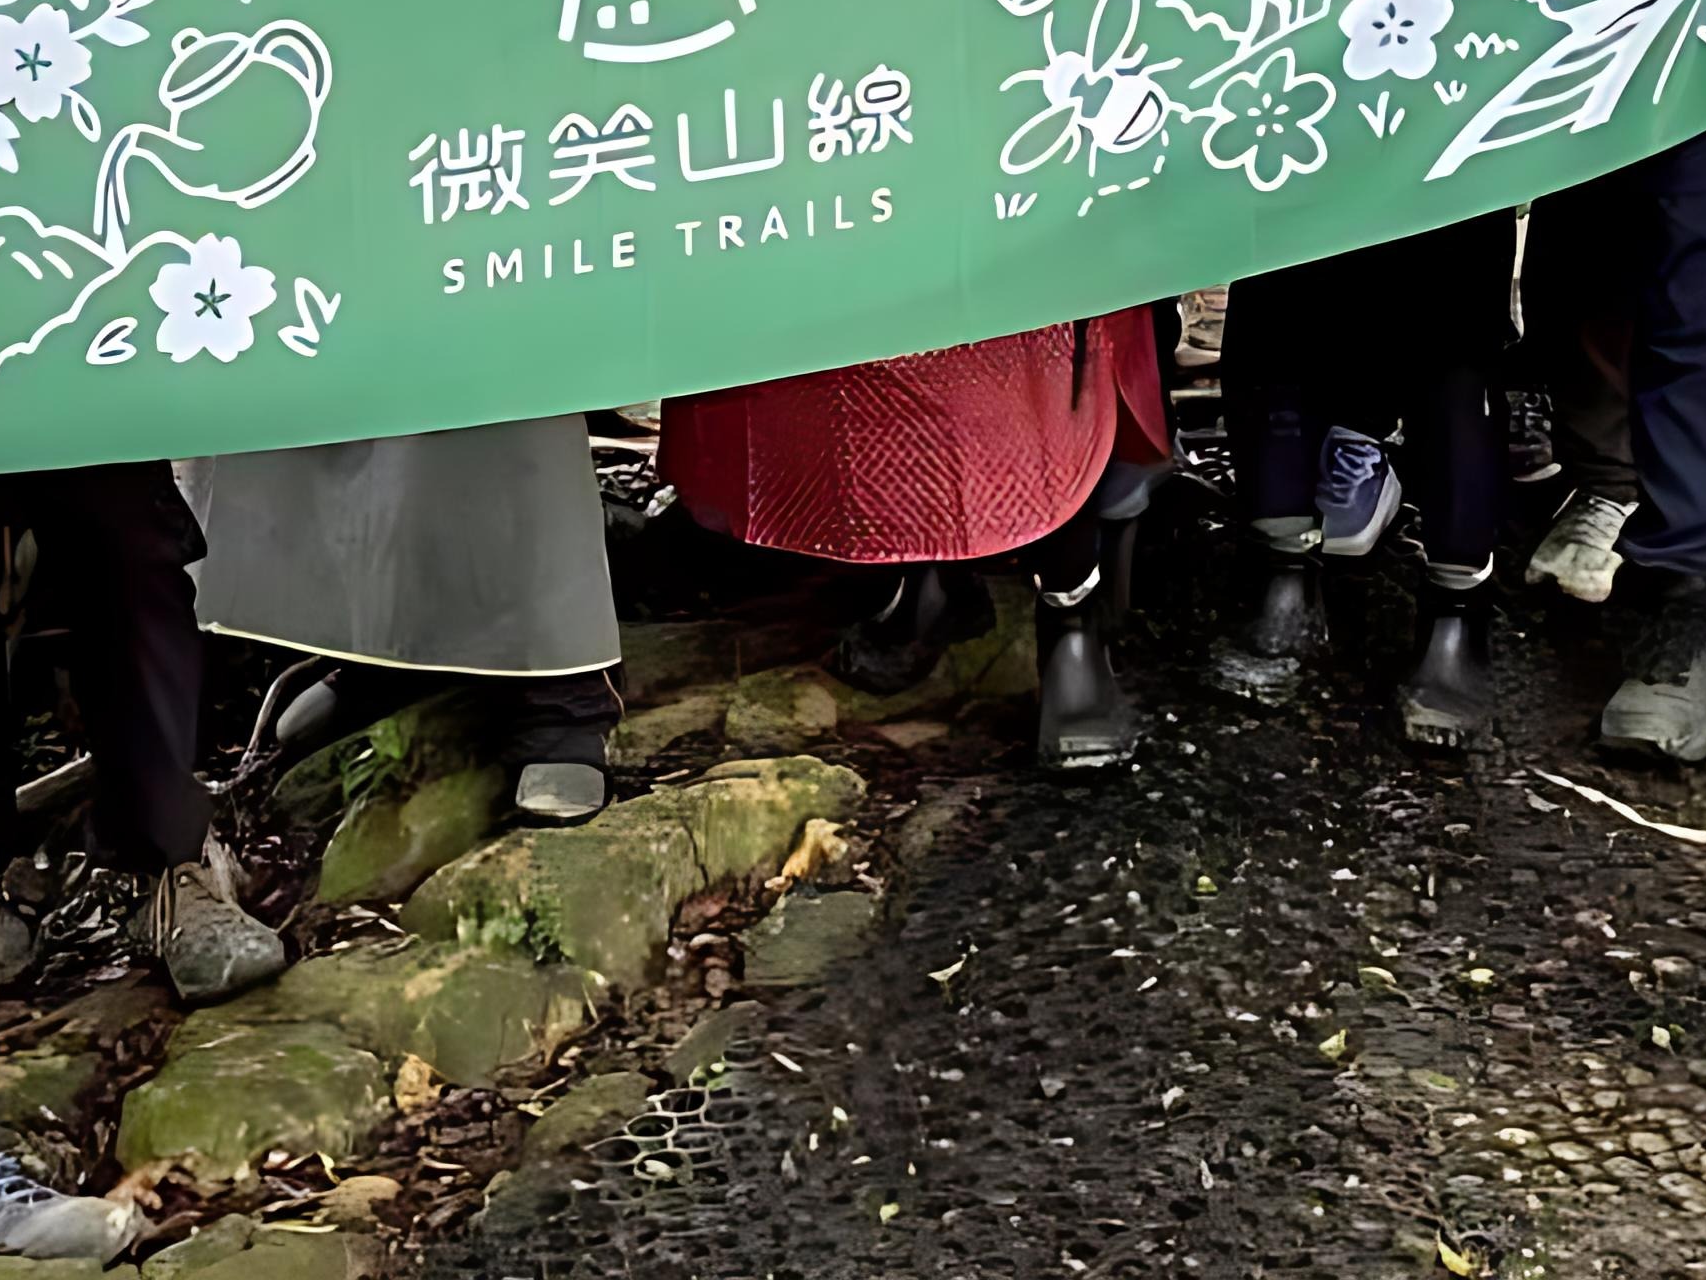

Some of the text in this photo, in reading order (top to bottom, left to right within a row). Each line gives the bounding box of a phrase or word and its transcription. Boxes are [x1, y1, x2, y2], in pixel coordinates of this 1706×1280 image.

[408, 63, 914, 225] 微笑山線
[442, 187, 893, 294] SMILE TRAILS
